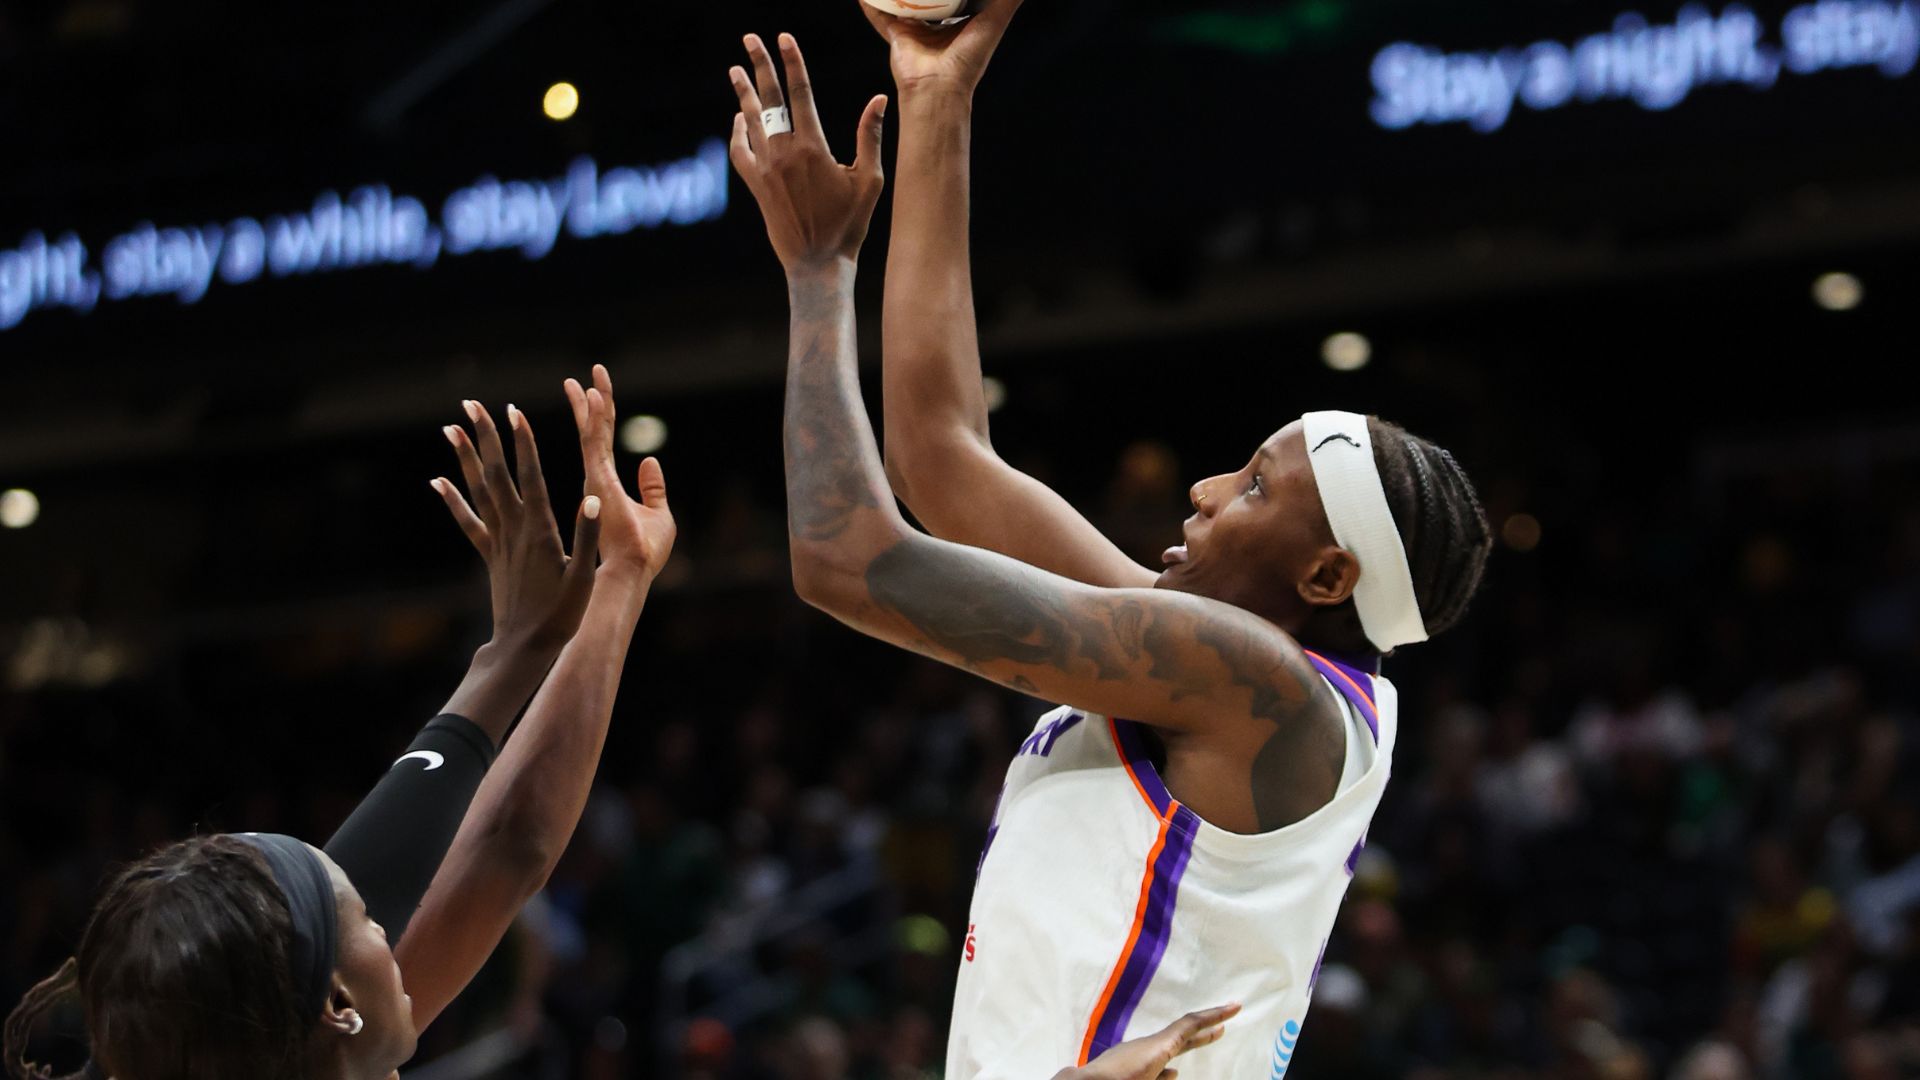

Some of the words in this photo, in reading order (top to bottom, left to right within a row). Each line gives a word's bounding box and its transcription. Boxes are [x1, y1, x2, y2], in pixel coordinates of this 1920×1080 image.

[1370, 41, 1523, 132] Stay
[1518, 40, 1572, 109] a
[1573, 3, 1781, 109] night,
[1782, 0, 1920, 75] stay
[103, 221, 223, 302] stay
[219, 216, 266, 284] a
[266, 184, 442, 276] while,
[443, 177, 568, 259] stay
[567, 138, 729, 238] Level
